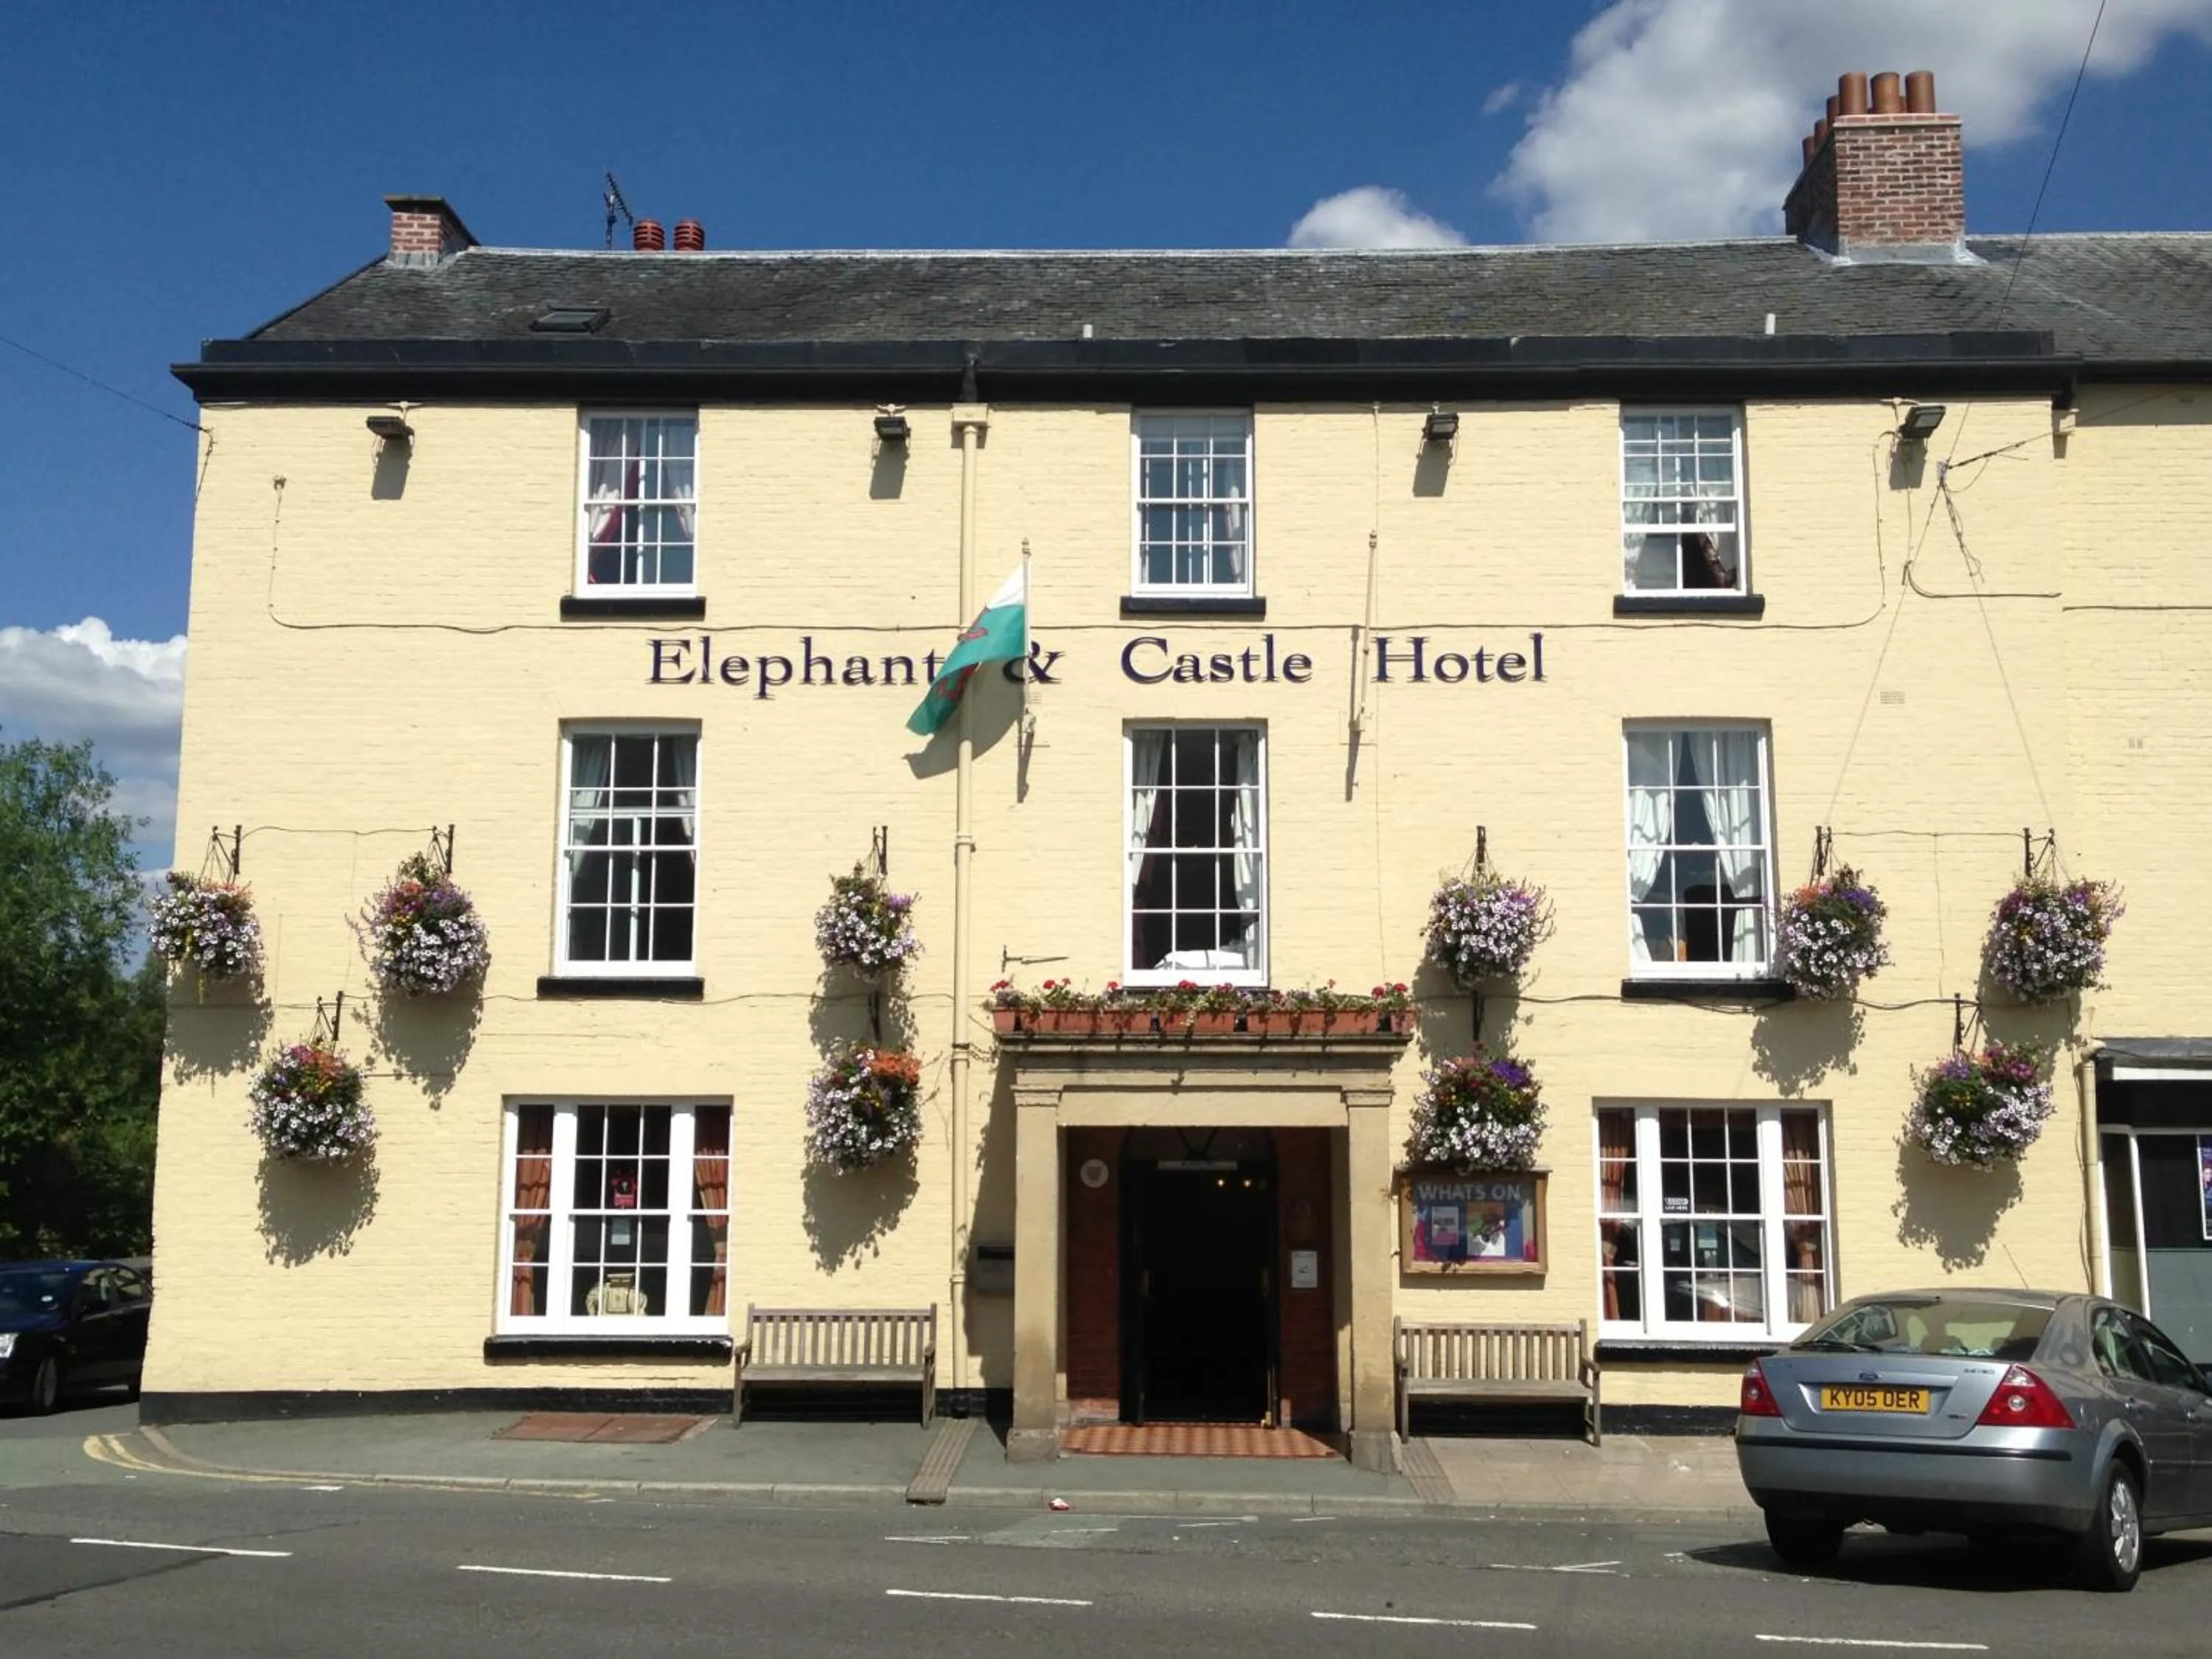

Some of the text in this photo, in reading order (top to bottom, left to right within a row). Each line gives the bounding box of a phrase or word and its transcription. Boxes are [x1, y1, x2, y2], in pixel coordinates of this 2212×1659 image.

[646, 633, 1547, 700] Elephant & Castle Hotel
[1419, 1183, 1521, 1201] WHATS ON
[1831, 1388, 1877, 1406] KY05
